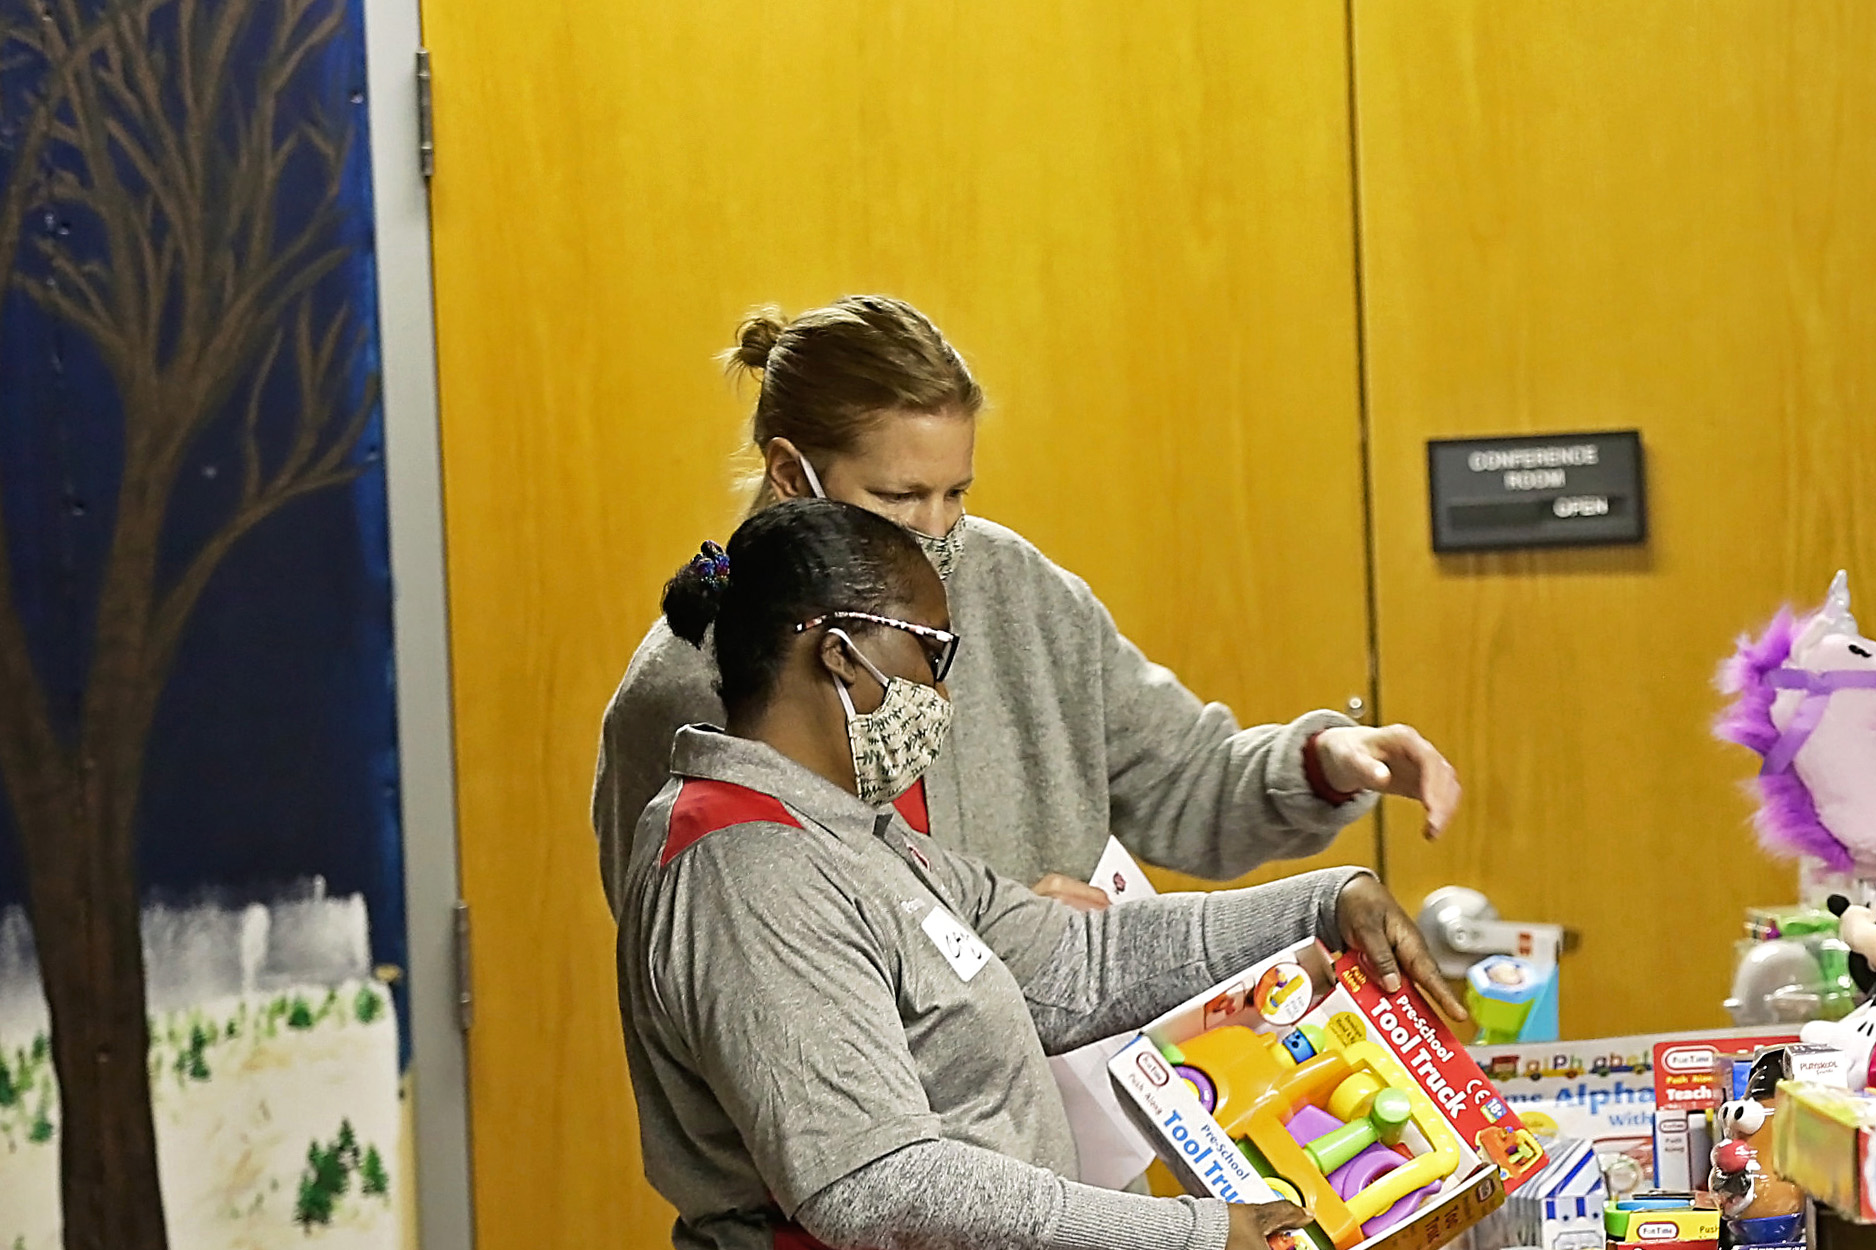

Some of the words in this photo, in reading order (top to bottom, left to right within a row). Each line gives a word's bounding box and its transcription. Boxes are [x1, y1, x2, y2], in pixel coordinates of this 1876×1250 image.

[1468, 444, 1599, 471] CONFERENCE
[1504, 468, 1566, 490] ROOM
[1553, 495, 1608, 518] OPEN
[1396, 995, 1455, 1063] Pre-School
[1370, 997, 1422, 1054] Tool
[1410, 1047, 1467, 1119] Truck
[1666, 1085, 1713, 1102] Teach
[1164, 1109, 1213, 1164] Tool
[1204, 1160, 1245, 1203] Tru
[1200, 1124, 1250, 1180] Pre-School
